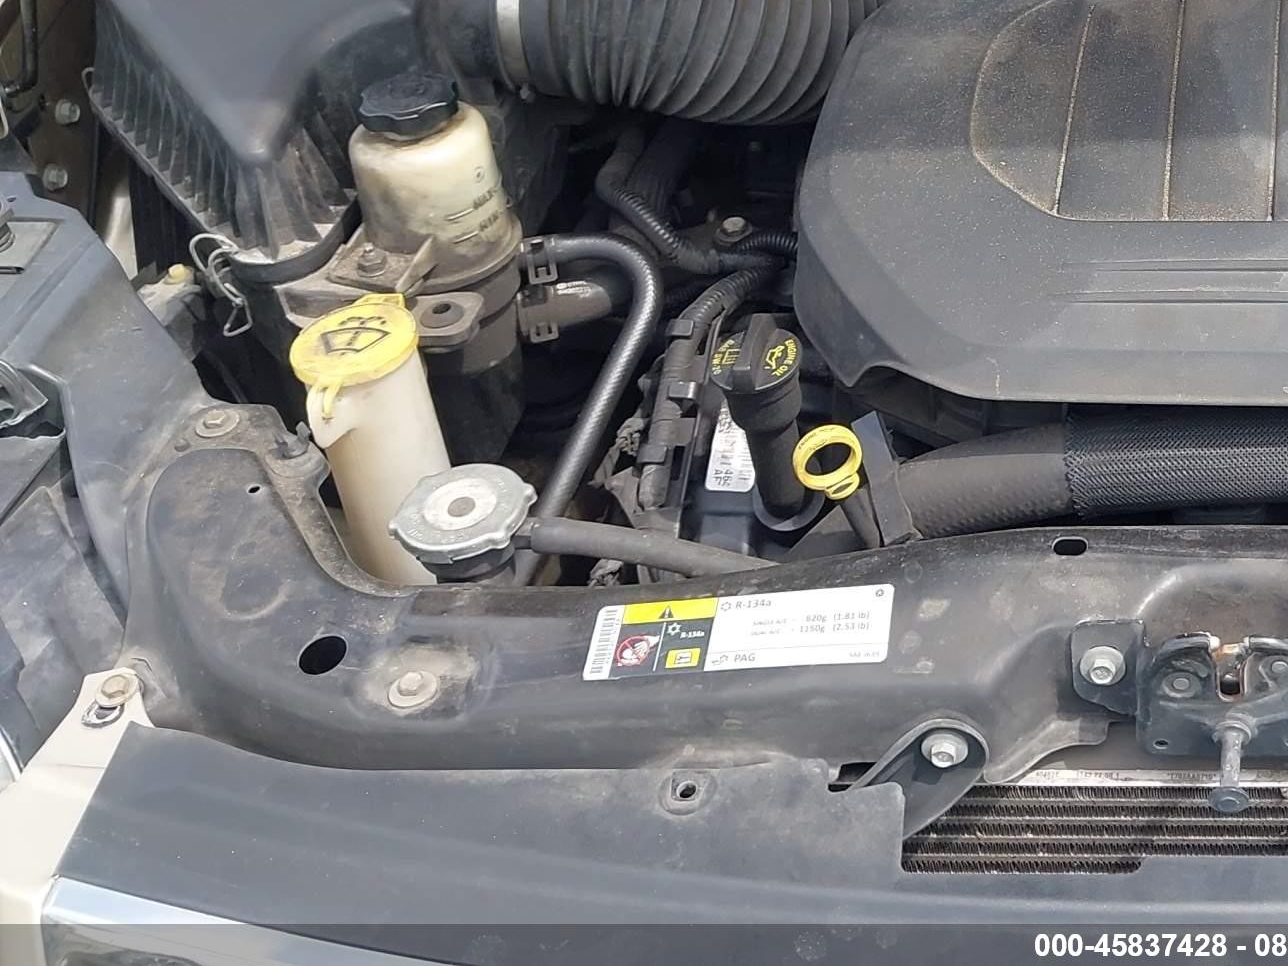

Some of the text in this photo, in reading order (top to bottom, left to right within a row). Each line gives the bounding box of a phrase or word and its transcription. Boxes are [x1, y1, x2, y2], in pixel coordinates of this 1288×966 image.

[771, 339, 797, 377] ENGINE OIL
[735, 599, 772, 610] R-134a
[734, 652, 756, 663] PAG
